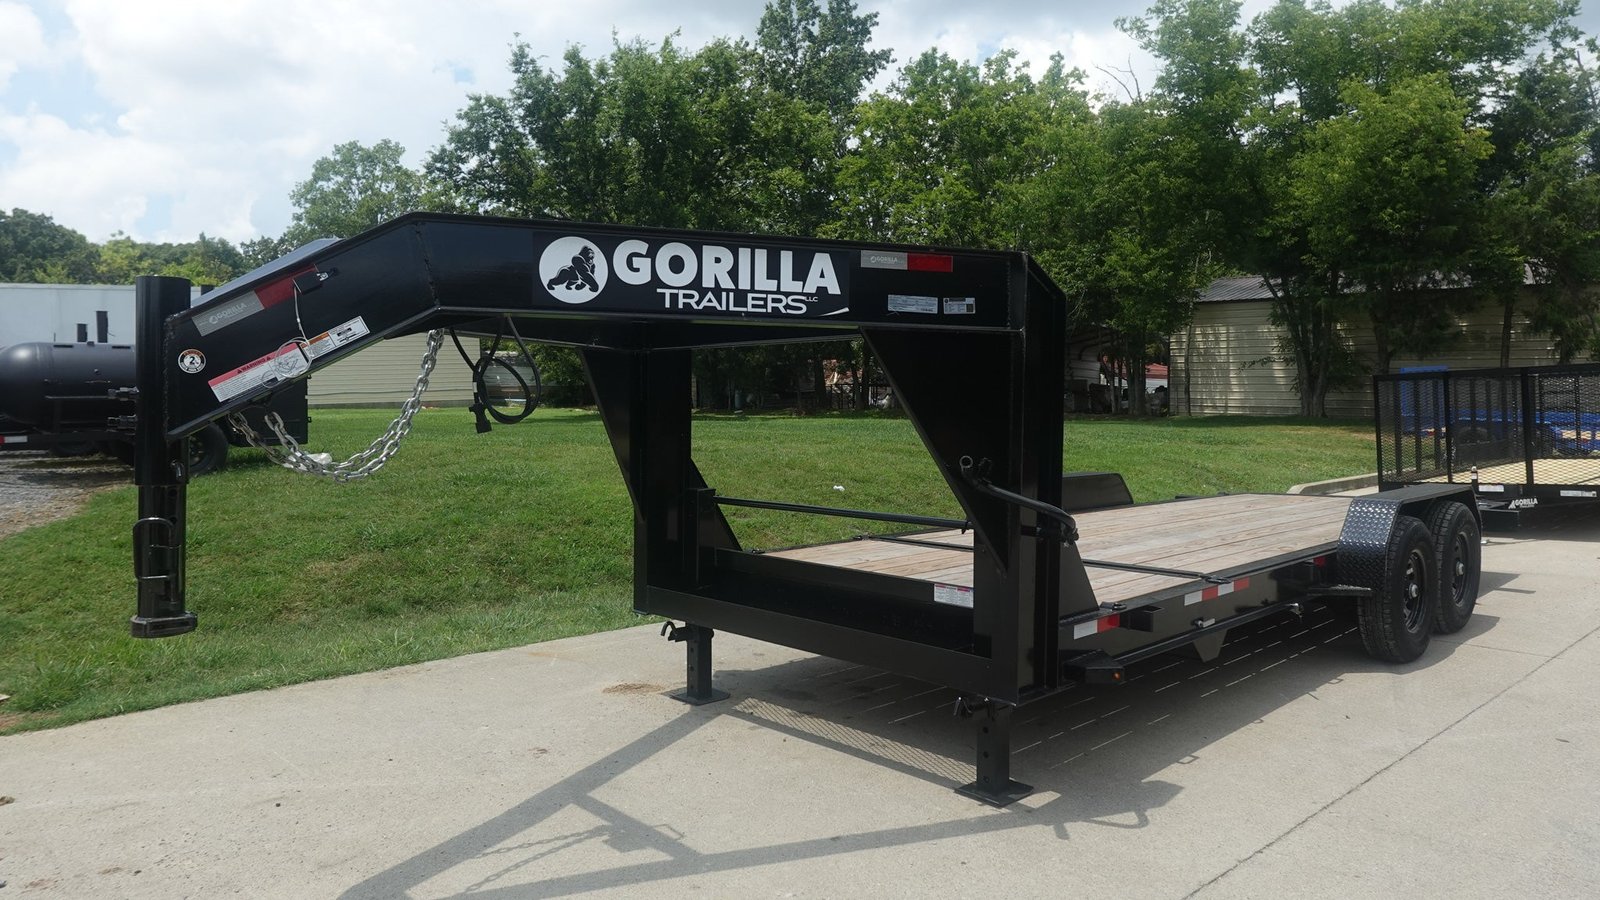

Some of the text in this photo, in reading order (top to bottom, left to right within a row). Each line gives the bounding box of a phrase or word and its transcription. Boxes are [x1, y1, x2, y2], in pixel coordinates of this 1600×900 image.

[612, 239, 842, 296] GORILLA
[656, 287, 808, 315] TRAILERS
[1514, 497, 1538, 506] GORILLA
